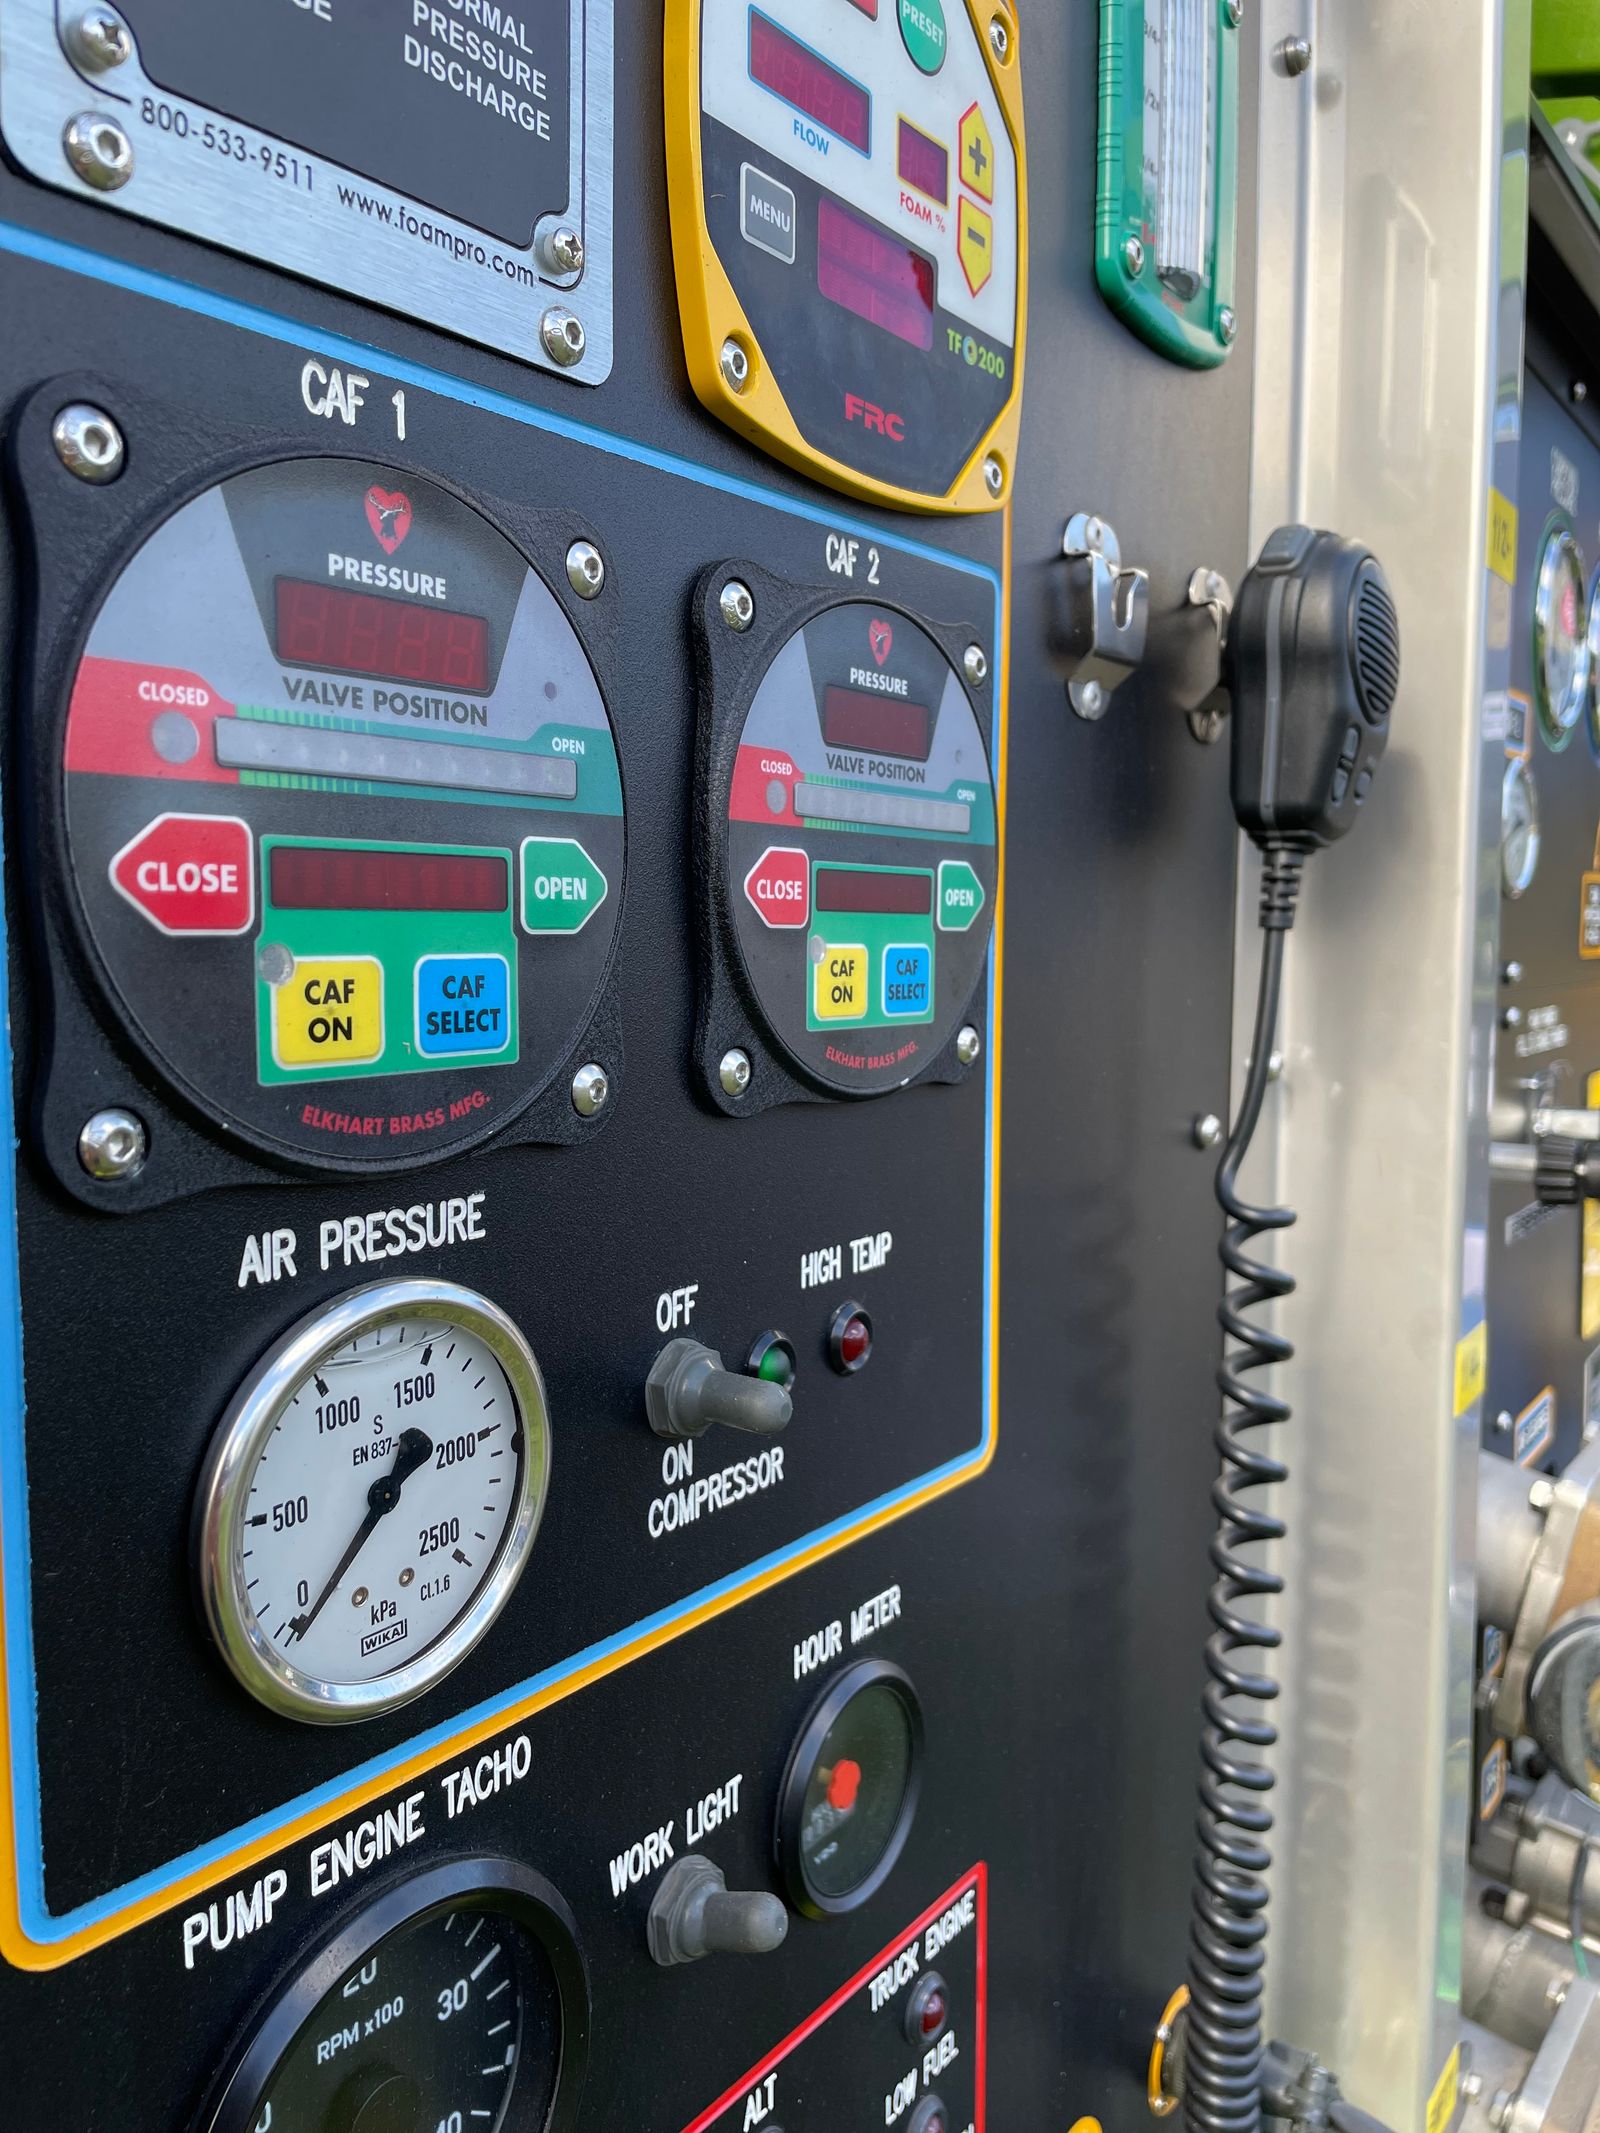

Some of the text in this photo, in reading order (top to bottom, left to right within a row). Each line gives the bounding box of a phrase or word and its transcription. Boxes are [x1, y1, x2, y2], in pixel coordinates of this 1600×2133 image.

[902, 1, 944, 47] PRESET
[413, 0, 547, 100] PRESSURE
[404, 34, 550, 141] DISCHARGE
[141, 98, 314, 191] 800-533-9511
[793, 118, 830, 156] FLOW
[750, 194, 791, 233] MENU
[900, 192, 946, 234] FOAM %
[337, 182, 535, 288] www.foampro.com
[301, 359, 406, 441] CAF 1
[845, 392, 905, 442] FRC
[328, 553, 446, 599] PRESSURE
[826, 533, 880, 585] CAF 2
[138, 680, 209, 707] CLOSED
[850, 667, 908, 695] PRESSURE
[283, 676, 488, 728] VALVE POSITION
[551, 737, 585, 755] OPEN
[761, 759, 793, 775] CLOSED
[826, 753, 925, 783] VALVE POSITION
[957, 788, 976, 801] OPEN
[137, 861, 238, 894] CLOSE
[534, 876, 587, 901] OPEN
[757, 879, 802, 900] CLOSE
[945, 889, 974, 907] OPEN
[442, 974, 486, 999] CAF
[830, 959, 854, 977] CAF
[896, 959, 918, 976] CAF
[304, 978, 355, 1005] CAF
[831, 985, 853, 1003] ON
[888, 983, 926, 1000] SELECT
[308, 1017, 352, 1043] ON
[426, 1007, 501, 1036] SELECT
[825, 1046, 865, 1069] ELKHART
[867, 1053, 895, 1069] BRASS
[302, 1089, 492, 1135] ELKHART BRASS MFG.
[238, 1192, 486, 1288] AIR PRESSURE
[801, 1230, 892, 1289] HIGH TEMP
[656, 1284, 699, 1331] OFF
[393, 1372, 435, 1408] 1500
[315, 1396, 360, 1434] 1000
[373, 1414, 383, 1434] S
[353, 1445, 370, 1466] EN
[435, 1432, 476, 1469] 2000
[662, 1439, 693, 1485] ON
[648, 1446, 784, 1538] COMPRESSOR
[273, 1495, 308, 1532] 500
[419, 1517, 459, 1556] 2500
[297, 1580, 309, 1606] 0
[370, 1600, 397, 1625] kPa
[364, 1627, 400, 1650] WIKA
[793, 1584, 902, 1680] HOUR METER
[183, 1735, 532, 1970] PUMP ENGINE TACHO
[608, 1819, 675, 1897] WORK
[685, 1773, 743, 1845] LIGHT
[868, 1889, 975, 2013] TRUCK ENGINE
[437, 1978, 468, 2021] 30
[317, 1996, 404, 2065] RPM x100
[884, 2029, 959, 2127] LOW FUEL
[742, 2072, 778, 2132] ALT
